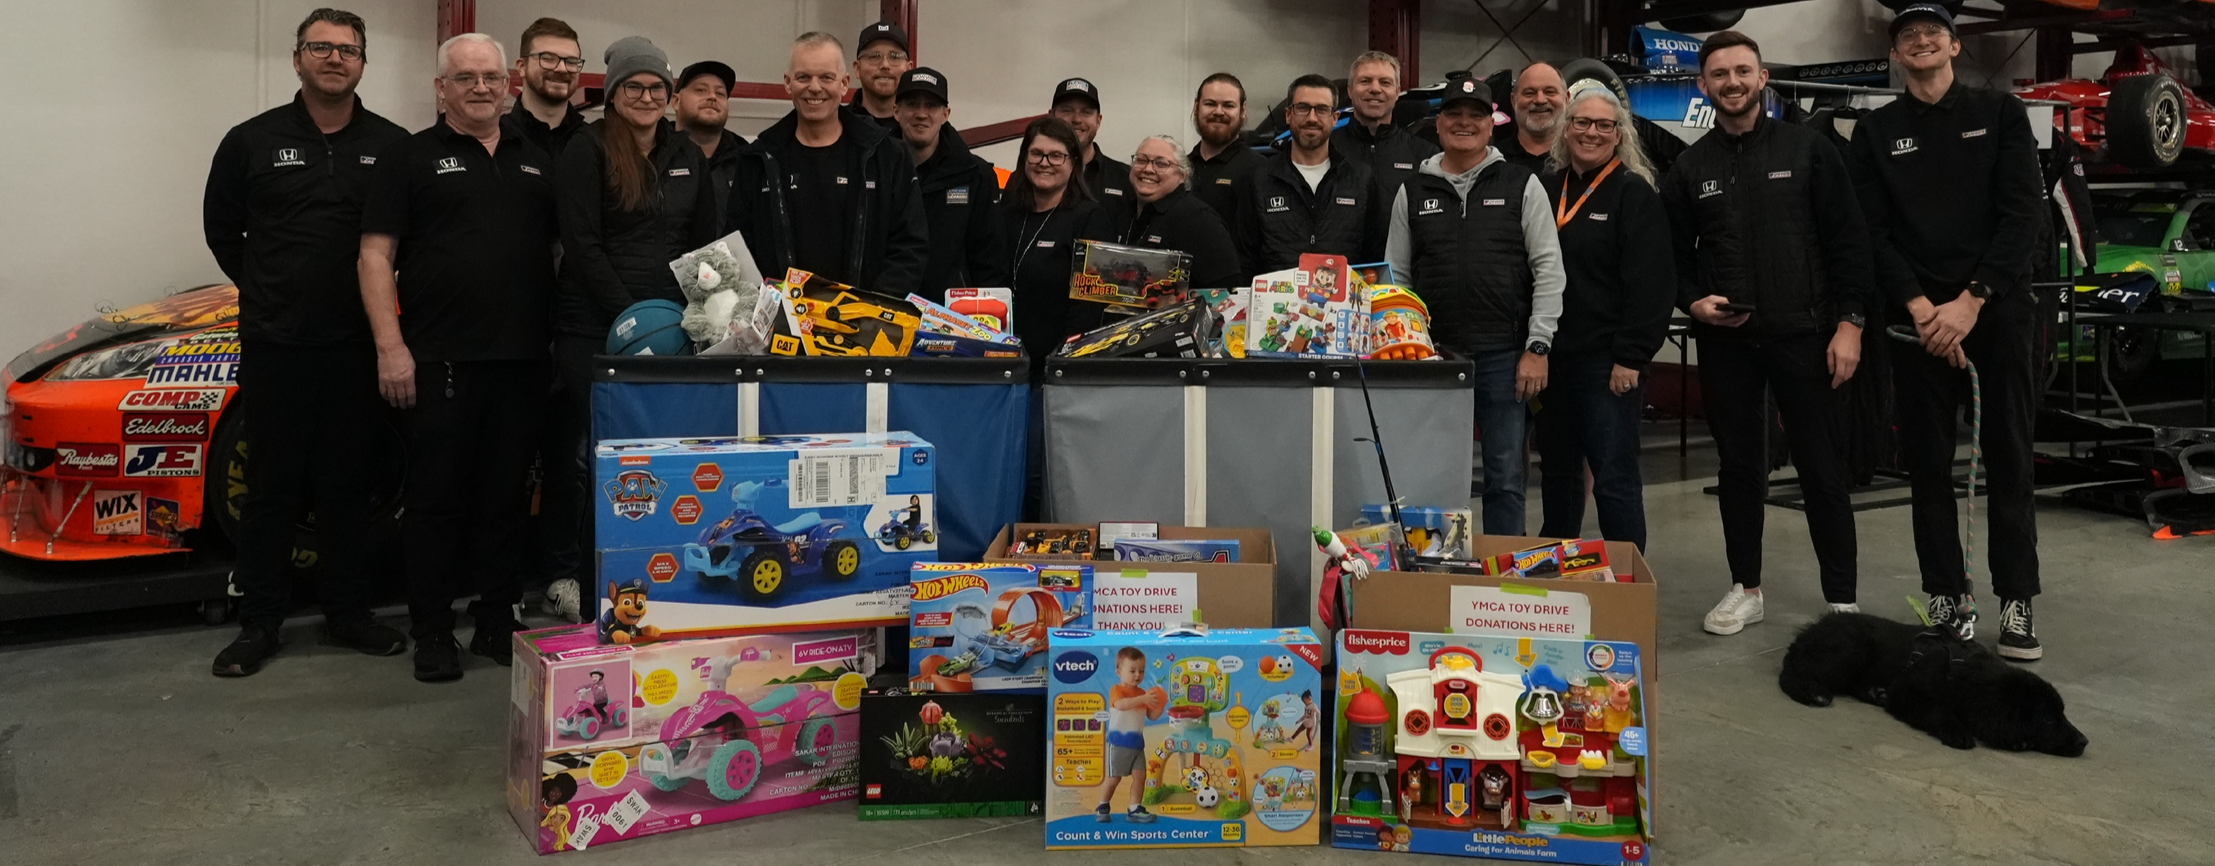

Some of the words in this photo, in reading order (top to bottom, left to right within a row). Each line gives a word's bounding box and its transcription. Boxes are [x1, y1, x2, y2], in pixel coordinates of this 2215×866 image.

[1654, 38, 1702, 52] HOND
[1892, 146, 1918, 155] HONDA
[437, 166, 467, 174] HONDA
[1699, 190, 1723, 200] HONDA
[1074, 274, 1097, 286] ROCK
[1078, 285, 1117, 297] CLIMBER
[1269, 285, 1295, 294] MARIO
[882, 311, 893, 320] CAT
[776, 339, 794, 352] CAT
[916, 338, 957, 347] ADVENTURE
[161, 343, 241, 356] MOOG
[160, 355, 203, 364] CHASSIS
[126, 391, 201, 406] COMP
[125, 418, 206, 435] Edelbrock
[58, 448, 119, 470] Raybestos
[125, 446, 197, 475] JE
[603, 478, 668, 503] PAW
[95, 493, 139, 519] WIX
[618, 503, 652, 511] PATROL
[95, 519, 140, 533] FILTERS
[915, 581, 941, 600] HOT
[940, 575, 986, 597] WHEELS
[1094, 587, 1118, 597] MCA
[1120, 587, 1141, 597] TOY
[1145, 587, 1177, 597] DRIVE
[1093, 604, 1147, 614] ONATIONS
[1150, 604, 1183, 614] HERE!
[1472, 600, 1506, 612] YMCA
[1509, 603, 1531, 613] TOY
[1534, 605, 1569, 615] DRIVE
[1098, 621, 1136, 630] THANK
[1466, 618, 1536, 631] DONATIONS
[1539, 622, 1575, 633] HERE!
[1348, 634, 1407, 648] fisher-price
[798, 649, 808, 658] 6V
[809, 646, 835, 656] RIDE-ON
[834, 644, 853, 654] ATV
[1299, 645, 1318, 661] NEW
[1055, 660, 1095, 671] vtech
[1624, 730, 1639, 738] 45+
[795, 748, 817, 757] SAKAR
[1057, 748, 1073, 756] 65+
[866, 787, 881, 795] LEGO
[626, 797, 644, 816] SWAK
[1056, 830, 1091, 841] Count
[1094, 830, 1102, 840] &
[1105, 830, 1127, 839] Win
[1130, 829, 1167, 842] Sports
[1171, 828, 1209, 839] Center
[1465, 844, 1490, 855] Caring
[1491, 845, 1503, 854] for
[1504, 846, 1535, 857] Animals
[1537, 849, 1557, 858] Farm
[1624, 845, 1640, 854] 1-5
